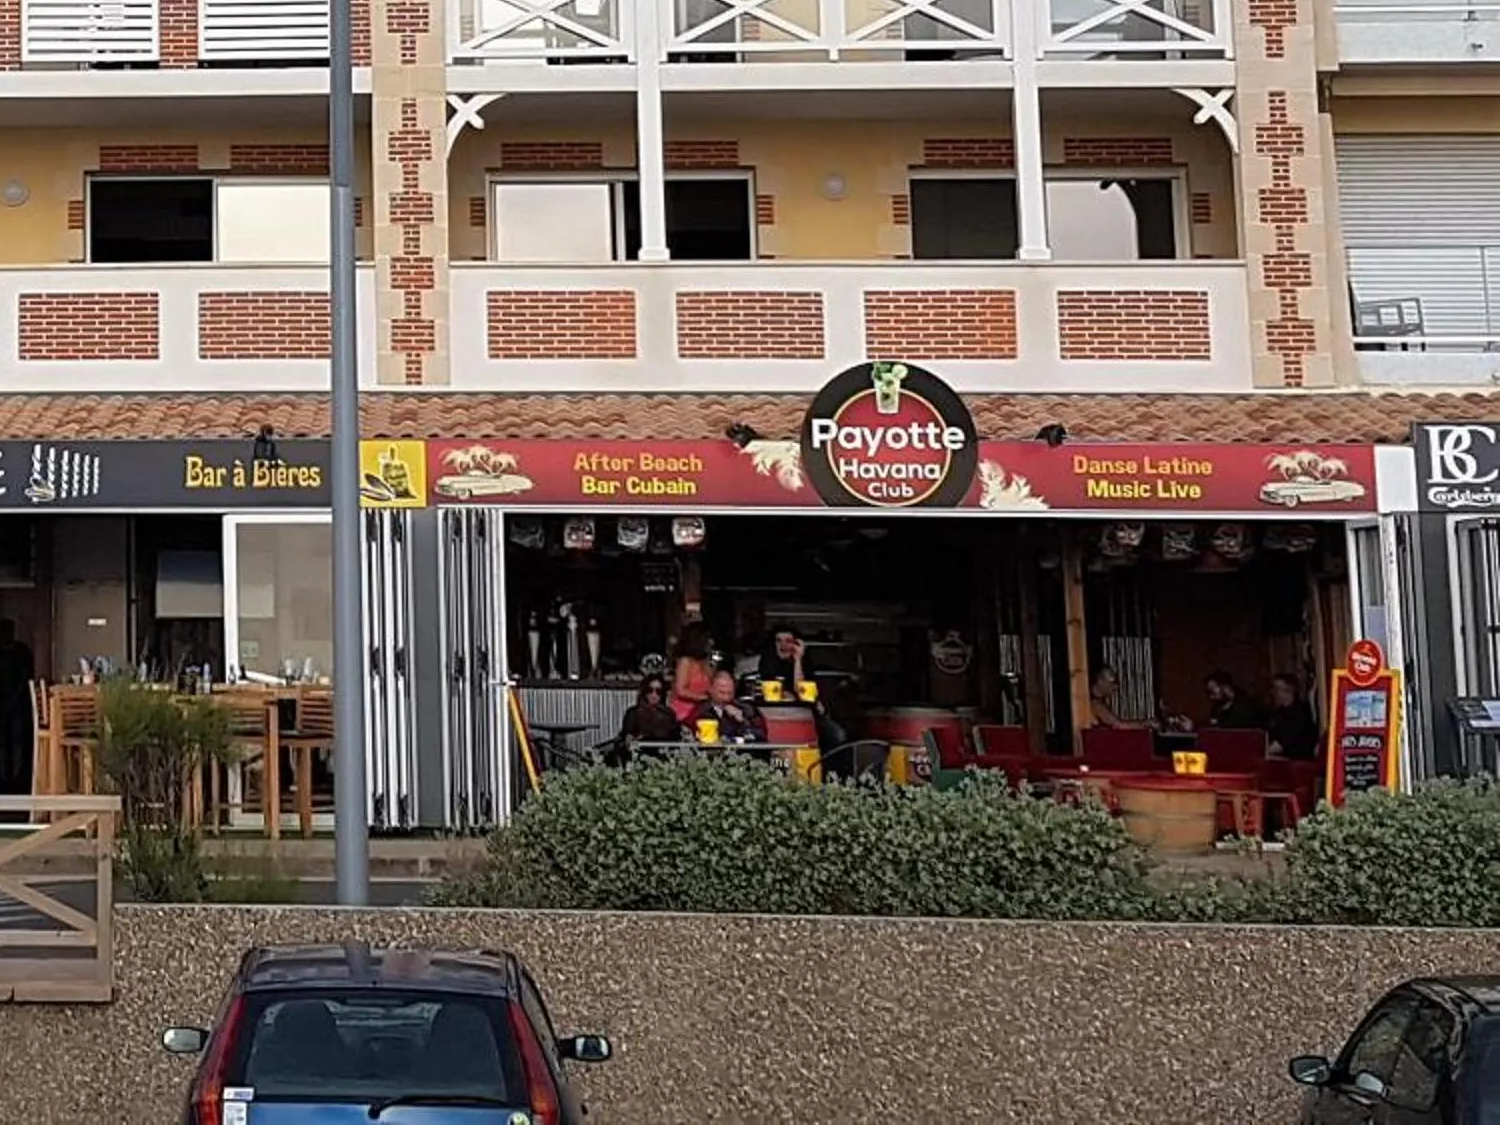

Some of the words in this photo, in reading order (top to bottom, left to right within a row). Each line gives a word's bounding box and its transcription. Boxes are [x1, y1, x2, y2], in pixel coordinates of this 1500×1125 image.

[811, 418, 965, 454] Payotte
[184, 456, 227, 488] Bar
[233, 459, 246, 488] à
[252, 459, 321, 488] Bières
[574, 452, 634, 472] After
[641, 452, 703, 472] Beach
[838, 459, 942, 483] Havana
[1073, 455, 1138, 475] Danse
[1144, 455, 1213, 475] Latine
[581, 476, 618, 495] Bar
[625, 475, 697, 495] Cubain
[867, 482, 915, 499] Club
[1087, 478, 1151, 499] Music
[1157, 478, 1202, 499] Live
